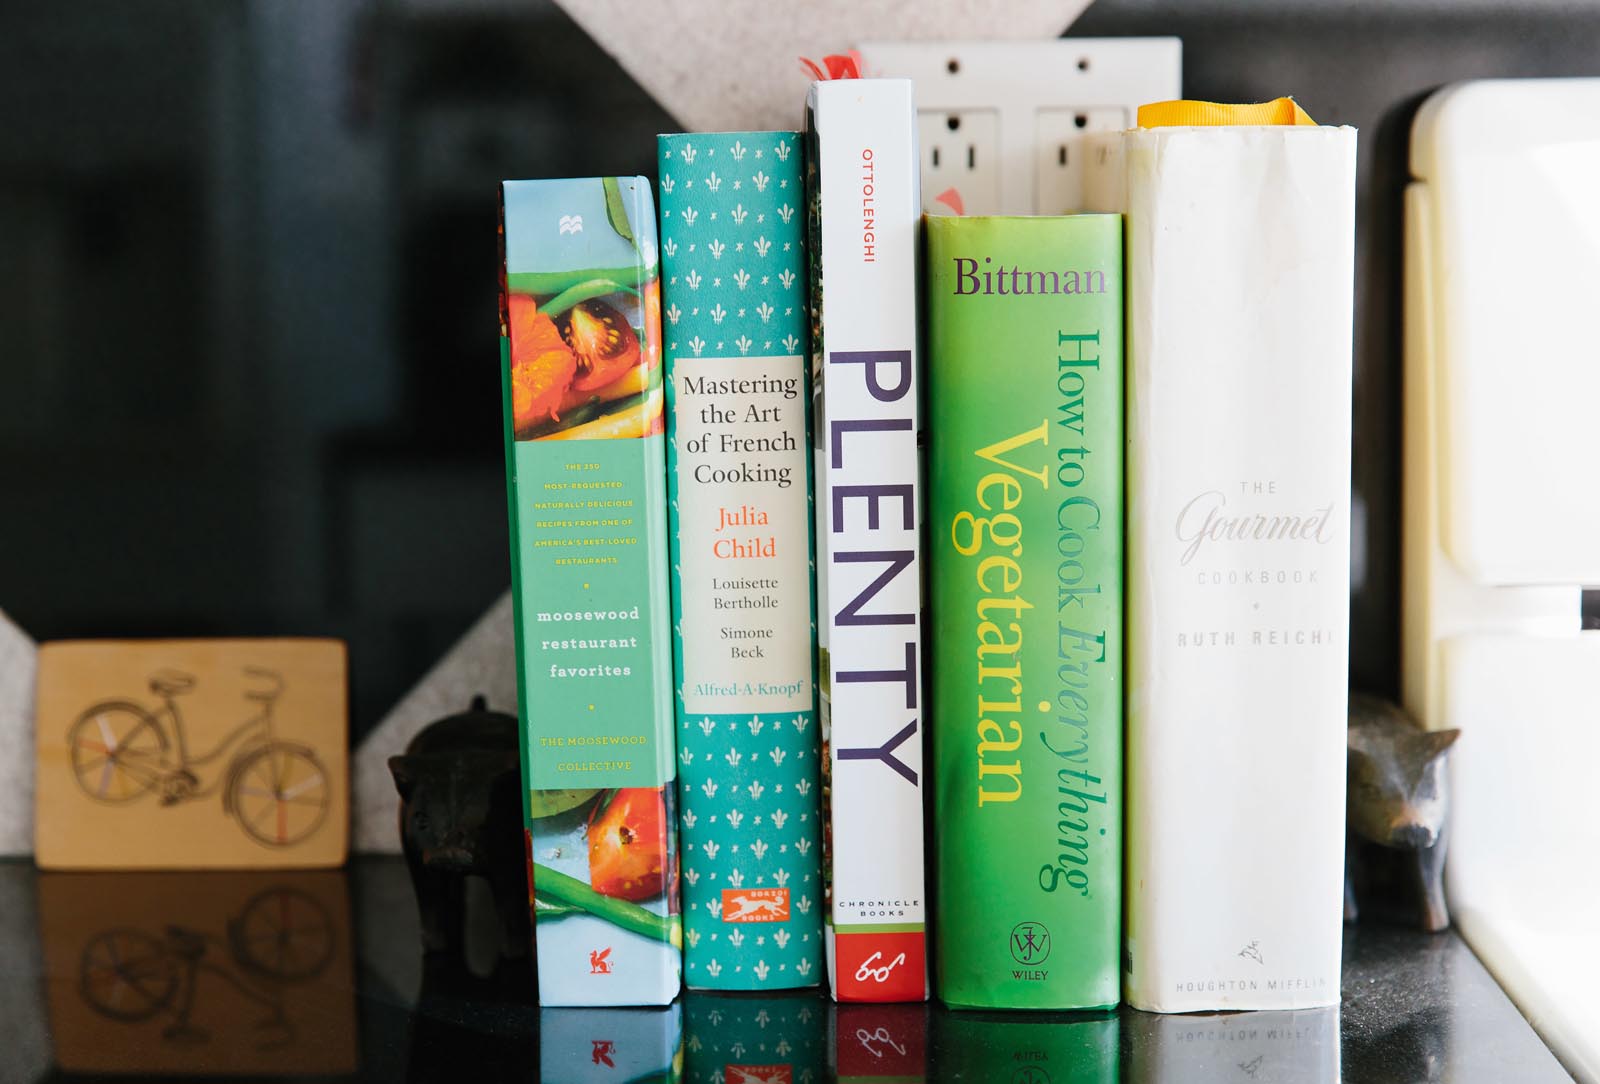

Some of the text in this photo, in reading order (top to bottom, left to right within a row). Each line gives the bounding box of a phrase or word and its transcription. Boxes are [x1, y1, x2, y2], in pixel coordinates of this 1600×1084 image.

[862, 148, 875, 263] OTTOLENGHI
[953, 256, 1109, 296] Bittman
[683, 374, 798, 400] Mastering
[700, 404, 782, 424] the Art
[686, 431, 797, 454] of French
[565, 463, 581, 471] THE
[694, 462, 792, 489] Cooking
[544, 481, 623, 490] MOST-REQUESTED
[1239, 481, 1277, 494] THE
[534, 499, 633, 509] NATURALLY DELICIOUS
[536, 520, 573, 528] RECIPES
[715, 505, 769, 532] Julia
[1175, 489, 1336, 568] Gourmet
[713, 536, 776, 559] Child
[555, 557, 618, 565] RESTAURANTS
[829, 349, 919, 788] PLENTY
[713, 577, 779, 590] Louisette
[1198, 570, 1319, 585] COOKBOOK
[713, 595, 779, 610] Bertholle
[537, 606, 640, 622] moosewood
[951, 418, 1051, 808] Vegetarian
[1038, 329, 1108, 898] How to Cook Everything
[720, 627, 774, 640] Simone
[1177, 631, 1236, 647] RUTH
[541, 637, 638, 650] restaurant
[731, 645, 765, 659] Beck
[549, 664, 632, 678] favorites
[540, 735, 647, 747] THE MOOSEWOOD
[557, 761, 633, 772] COLLECTIVE
[750, 889, 788, 898] BORZOI
[838, 899, 920, 908] CHRONICLE
[741, 914, 775, 922] BOOKS
[860, 909, 905, 917] BOOKS
[1011, 970, 1049, 981] WILEY
[1176, 980, 1258, 993] HOUGHTON
